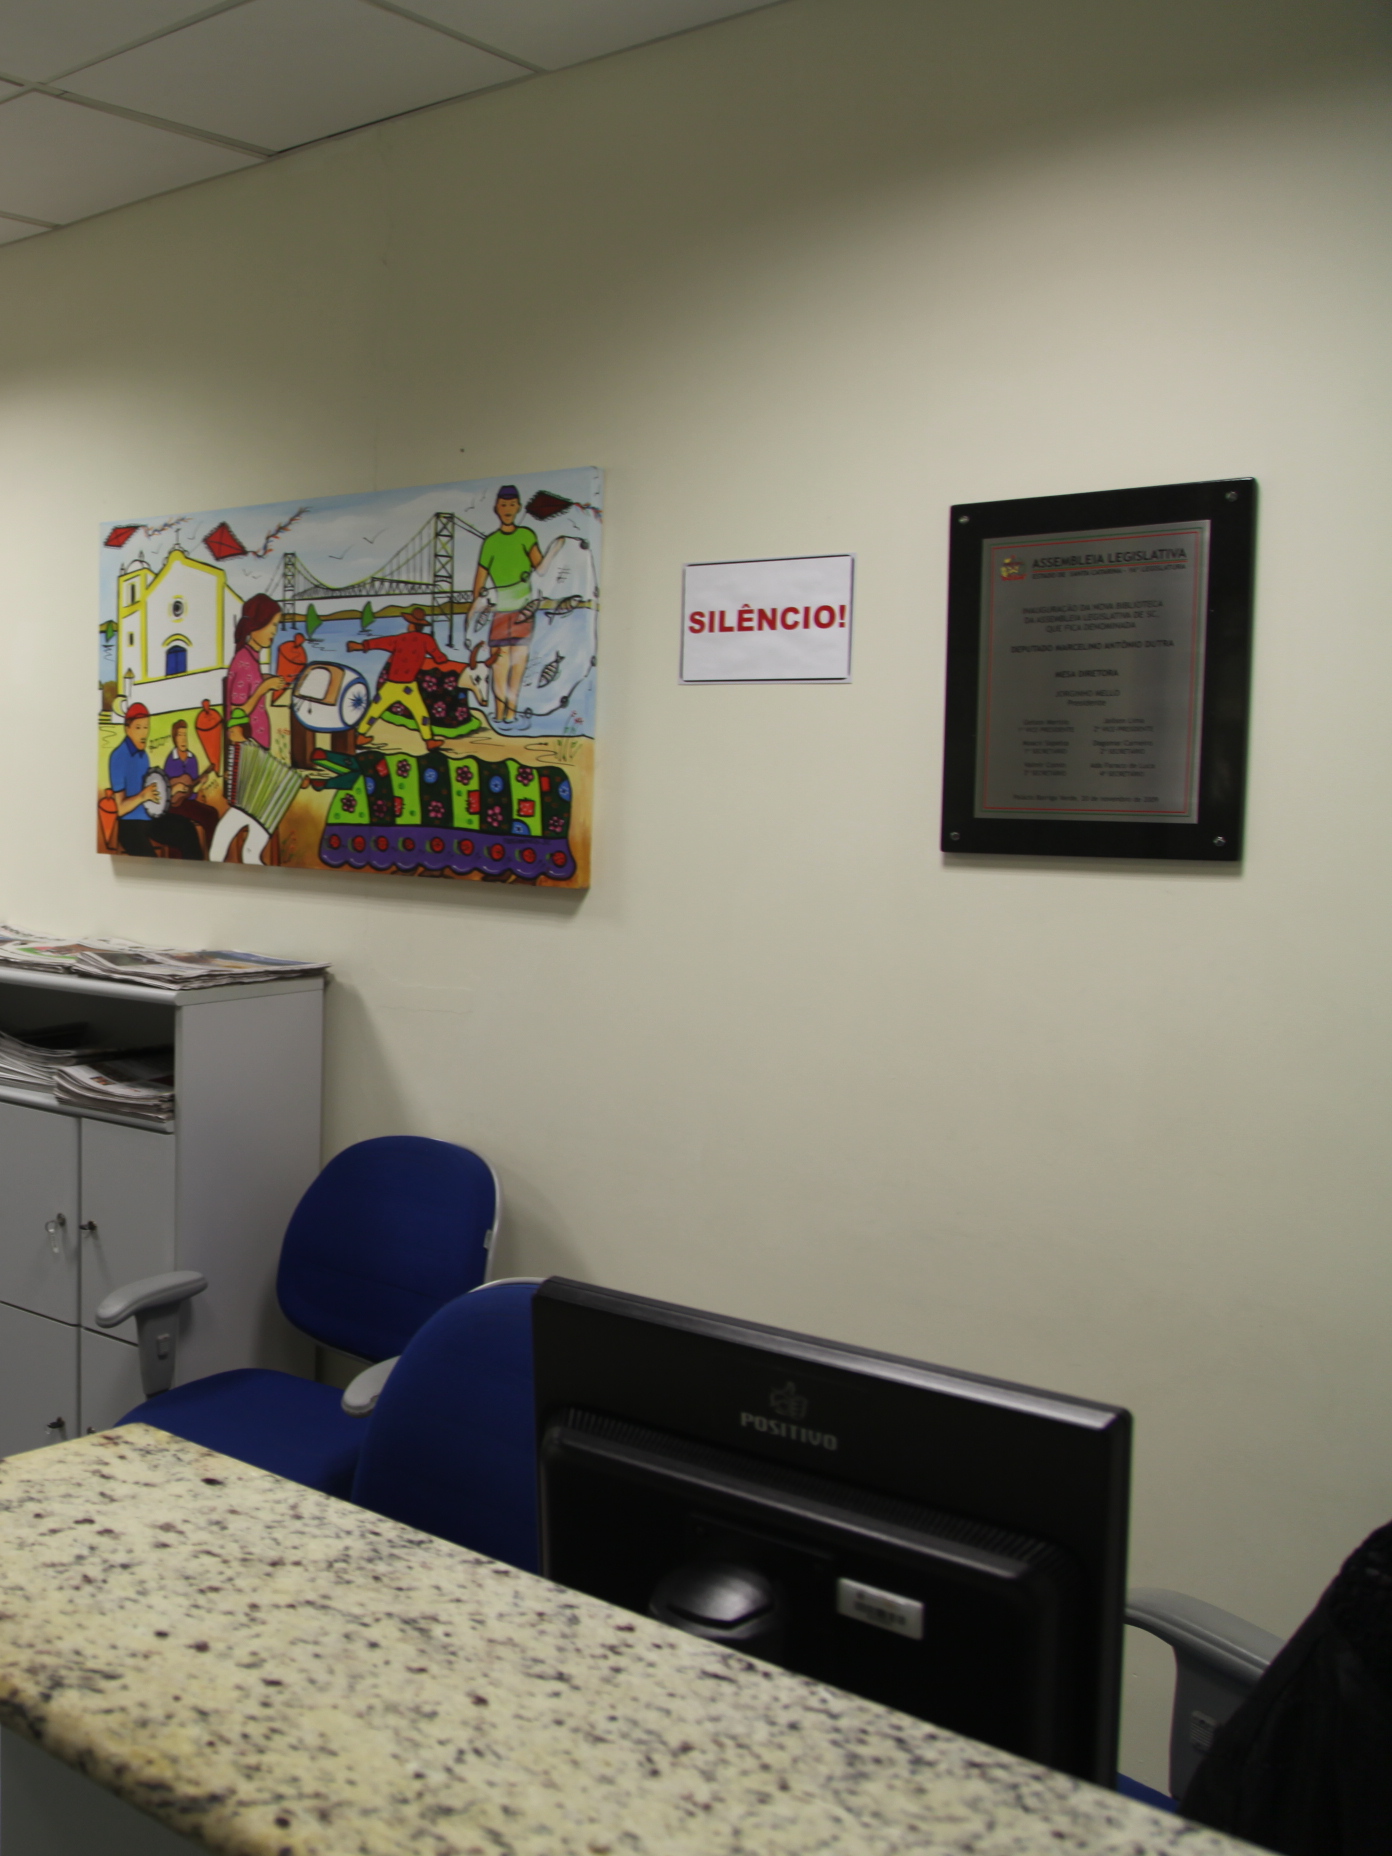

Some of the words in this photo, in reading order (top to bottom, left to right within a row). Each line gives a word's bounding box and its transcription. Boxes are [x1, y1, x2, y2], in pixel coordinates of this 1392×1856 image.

[1032, 554, 1104, 568] ASSEMBLEIA
[1108, 548, 1187, 563] LEGISLATIVA
[688, 604, 846, 634] SILÊNCIO!
[1045, 625, 1062, 633] QUE
[1064, 624, 1081, 632] FICA
[1145, 640, 1174, 648] DUTRA
[740, 1412, 838, 1450] POSITIVO
